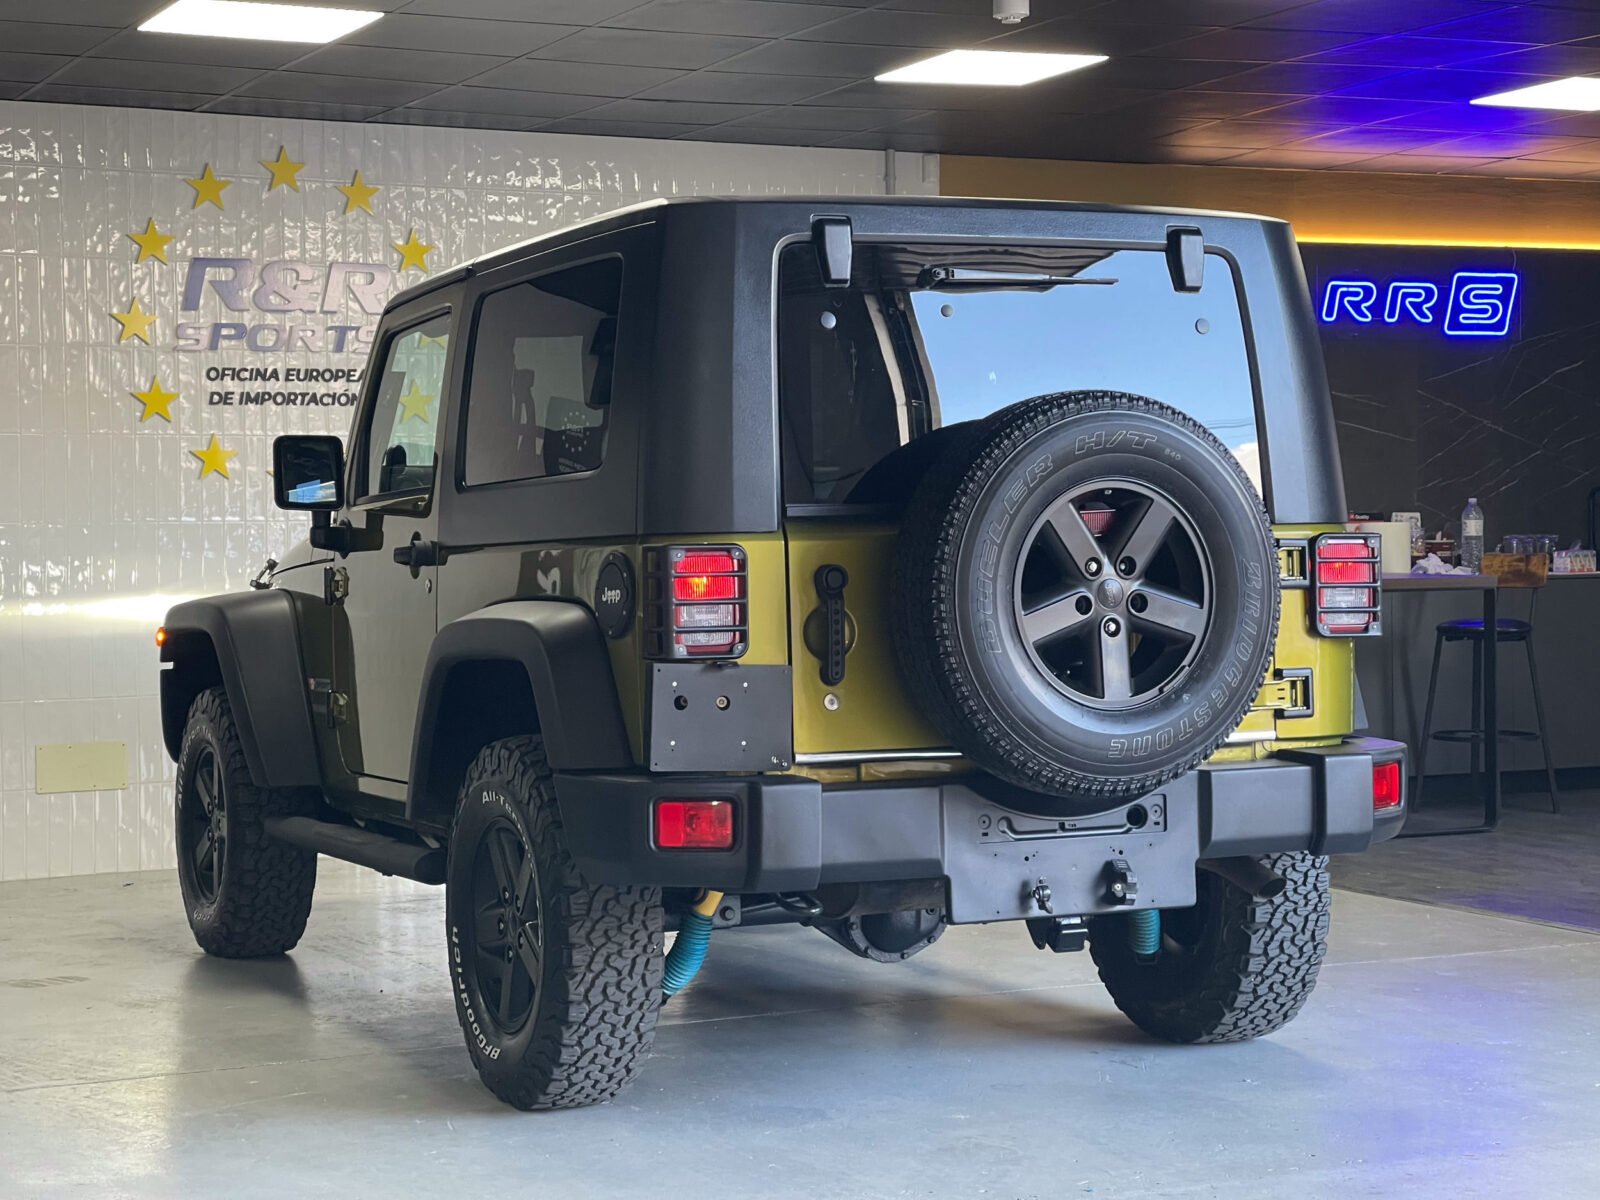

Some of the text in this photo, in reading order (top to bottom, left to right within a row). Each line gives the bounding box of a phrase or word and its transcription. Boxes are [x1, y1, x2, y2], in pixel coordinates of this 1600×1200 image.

[181, 257, 391, 314] R&R
[174, 322, 377, 353] SPORTS
[205, 366, 280, 382] OFICINA
[208, 391, 235, 406] DE
[601, 586, 621, 605] Jeep
[1107, 557, 1261, 759] BRIDGESTONE
[451, 925, 501, 1060] BFGoodrich
